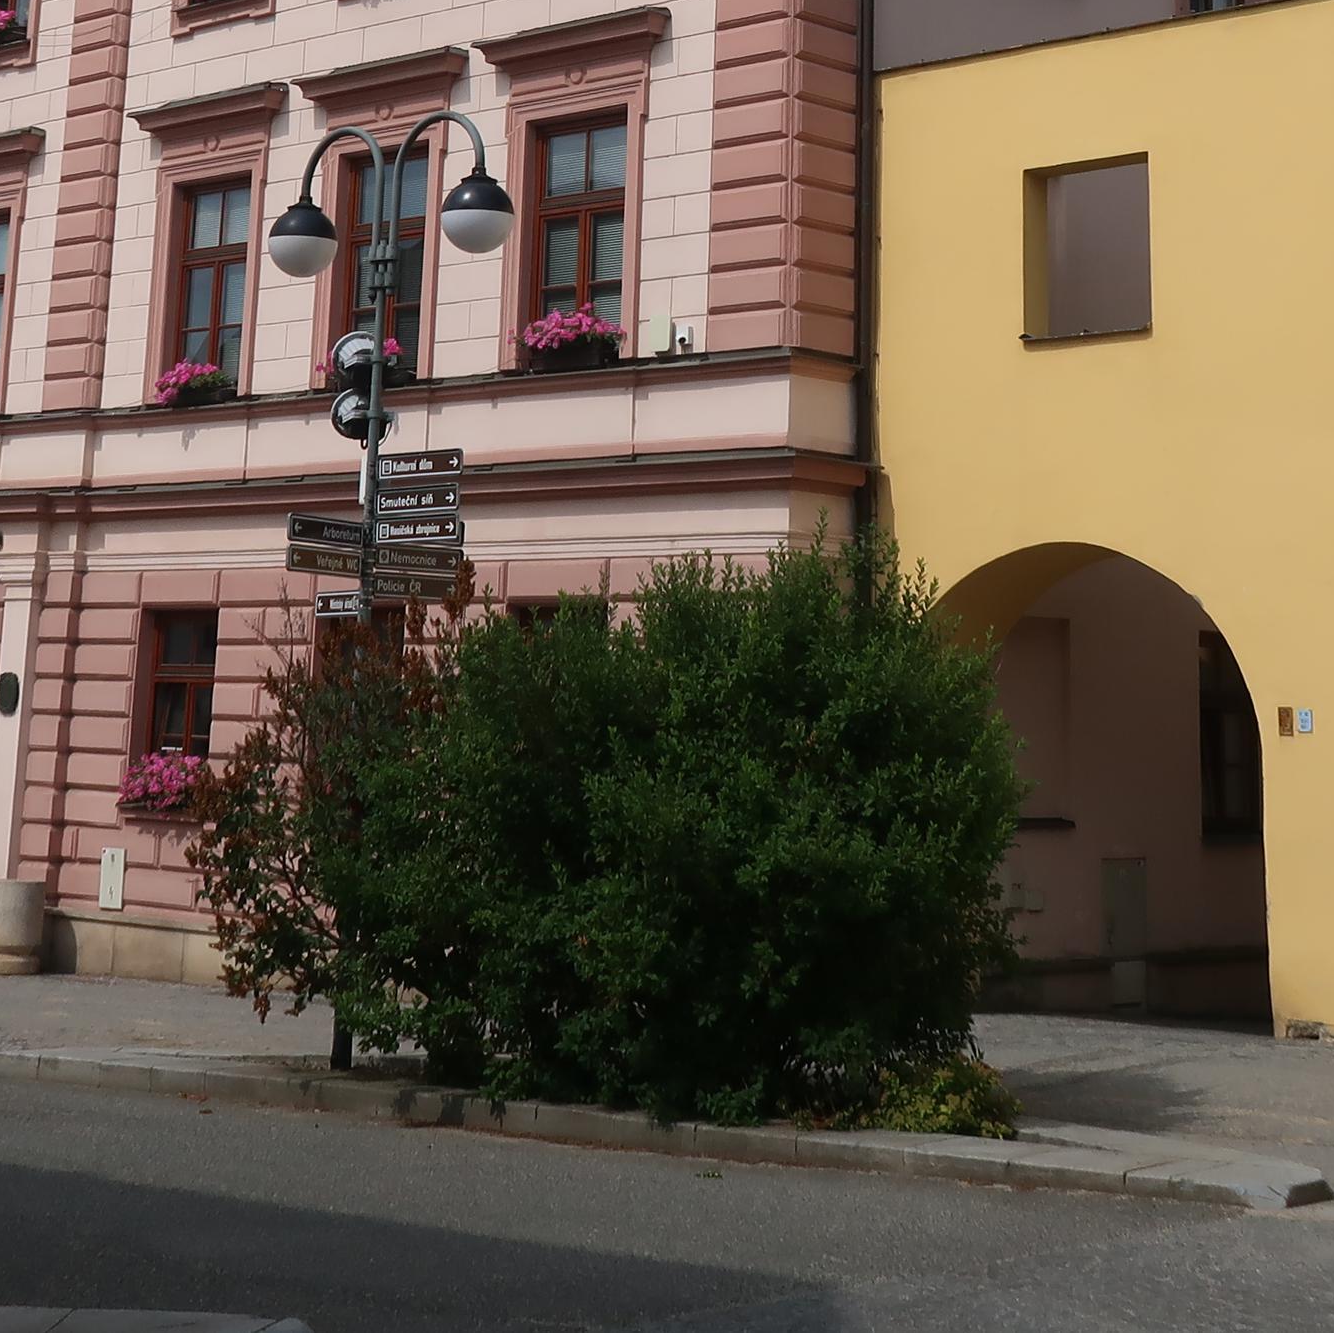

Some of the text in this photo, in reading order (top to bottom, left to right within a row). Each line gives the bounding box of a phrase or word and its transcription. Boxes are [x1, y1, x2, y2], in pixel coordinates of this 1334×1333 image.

[381, 493, 434, 508] Smuteční síň
[323, 526, 361, 541] Arboretum
[316, 554, 358, 571] Veřejné WC
[390, 551, 437, 566] Nemocnice
[377, 578, 422, 593] Policie ČR
